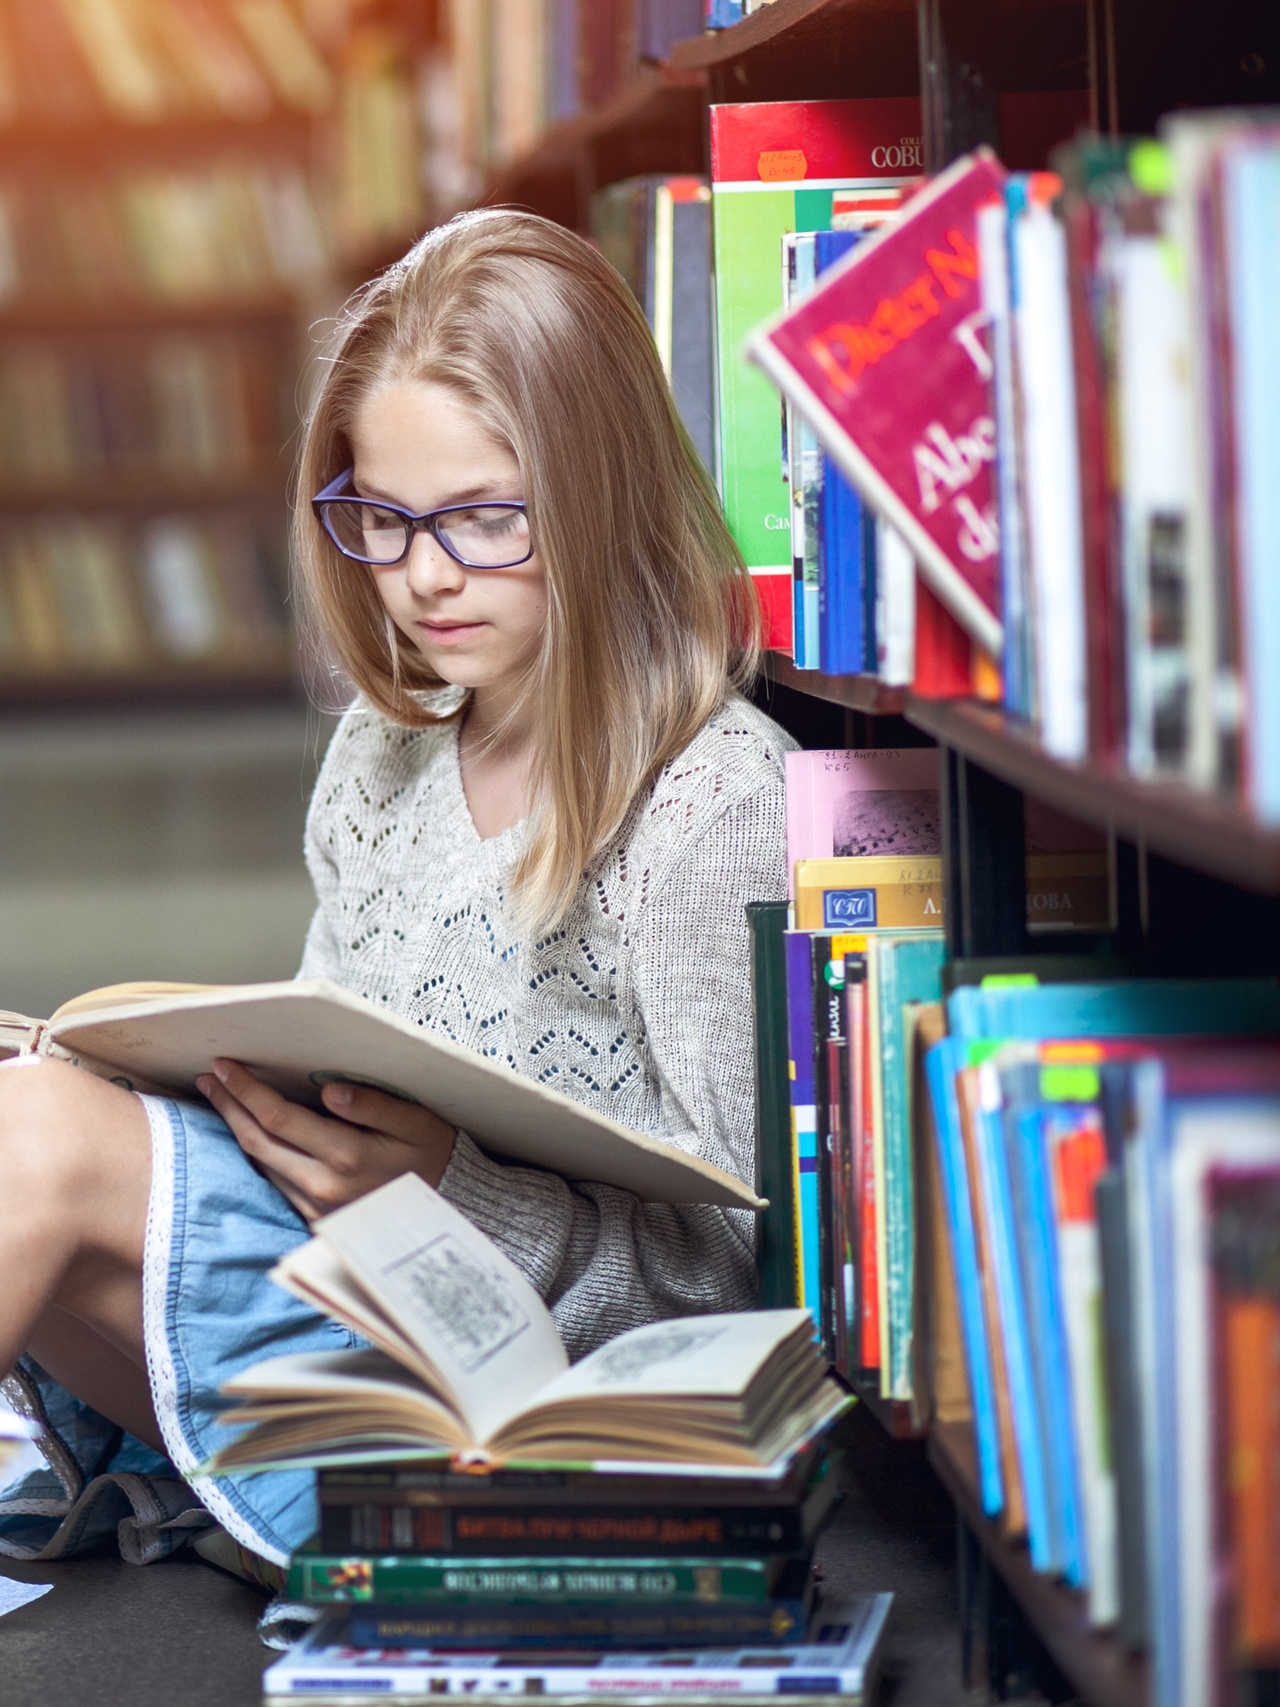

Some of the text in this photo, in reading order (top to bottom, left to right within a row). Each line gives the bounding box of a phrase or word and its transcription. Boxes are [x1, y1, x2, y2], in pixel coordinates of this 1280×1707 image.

[806, 272, 941, 394] Dieter
[457, 1516, 525, 1538] БИТВА
[528, 1517, 572, 1539] ПРИ
